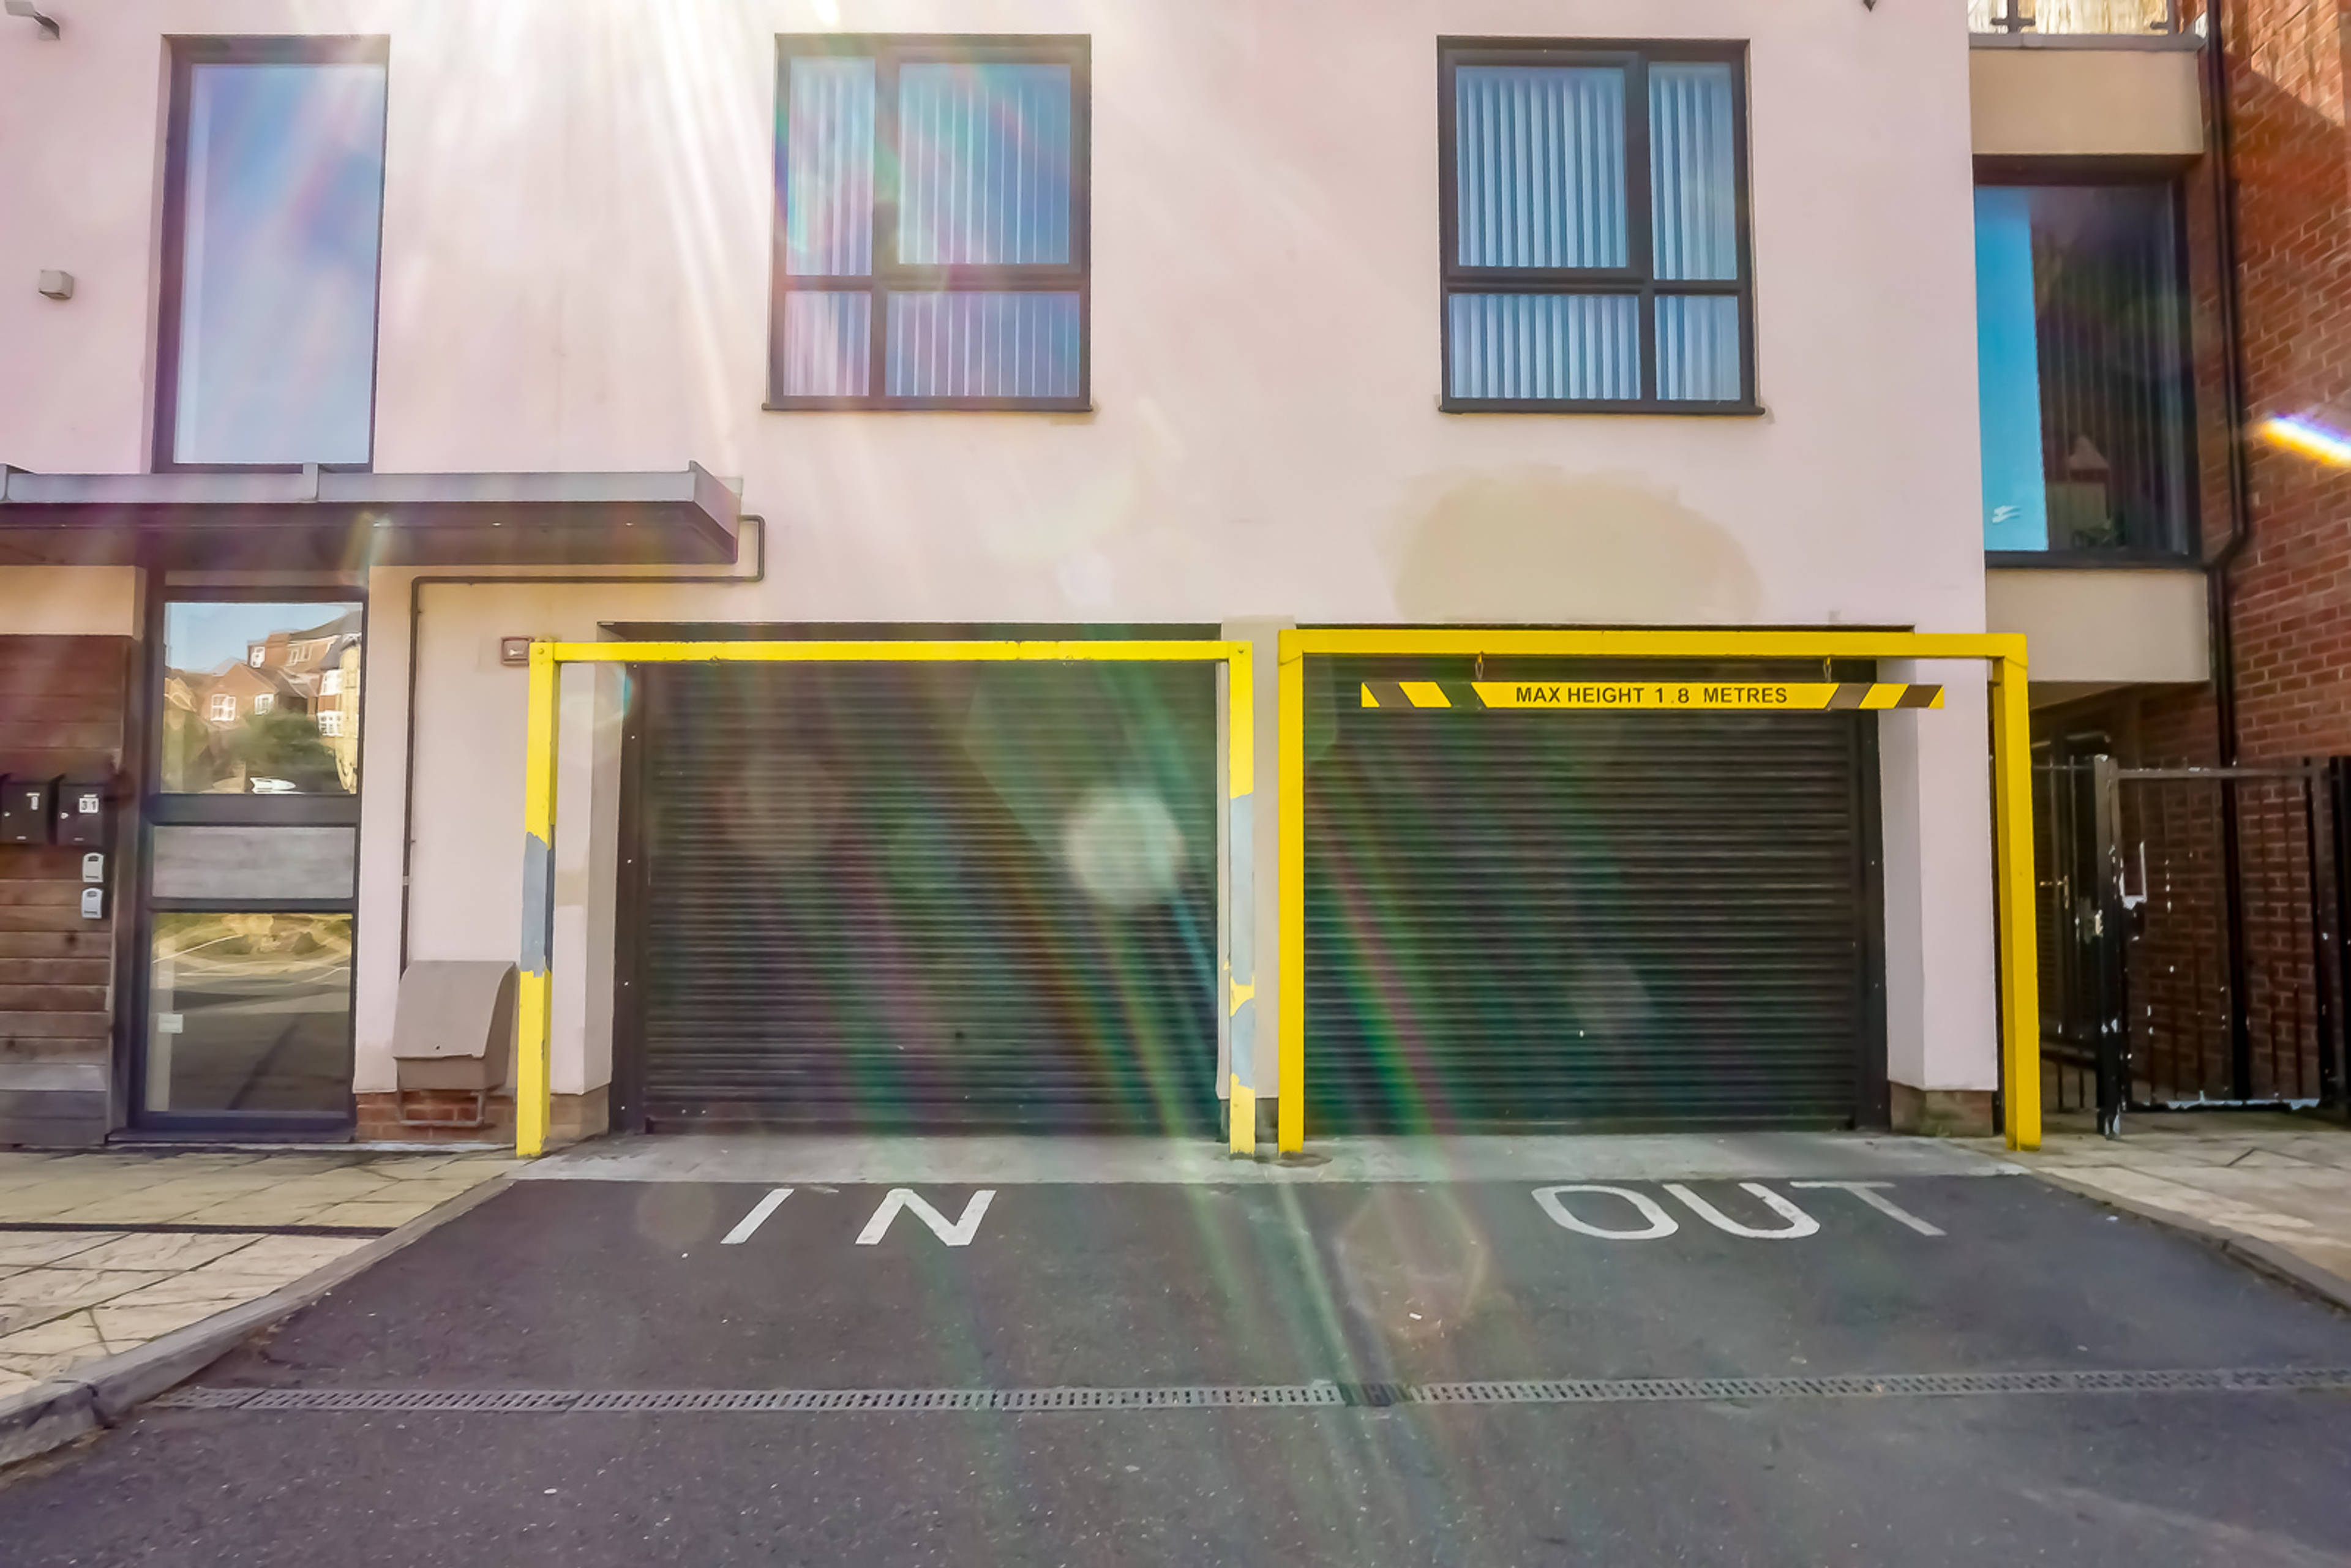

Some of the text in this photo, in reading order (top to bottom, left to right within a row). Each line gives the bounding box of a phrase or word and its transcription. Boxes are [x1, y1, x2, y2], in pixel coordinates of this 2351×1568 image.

[1516, 686, 1560, 702] MAX
[1567, 687, 1644, 703] HEIGHT
[1704, 687, 1787, 703] METRES
[719, 1188, 997, 1247] IN
[1531, 1181, 1948, 1240] OUT
